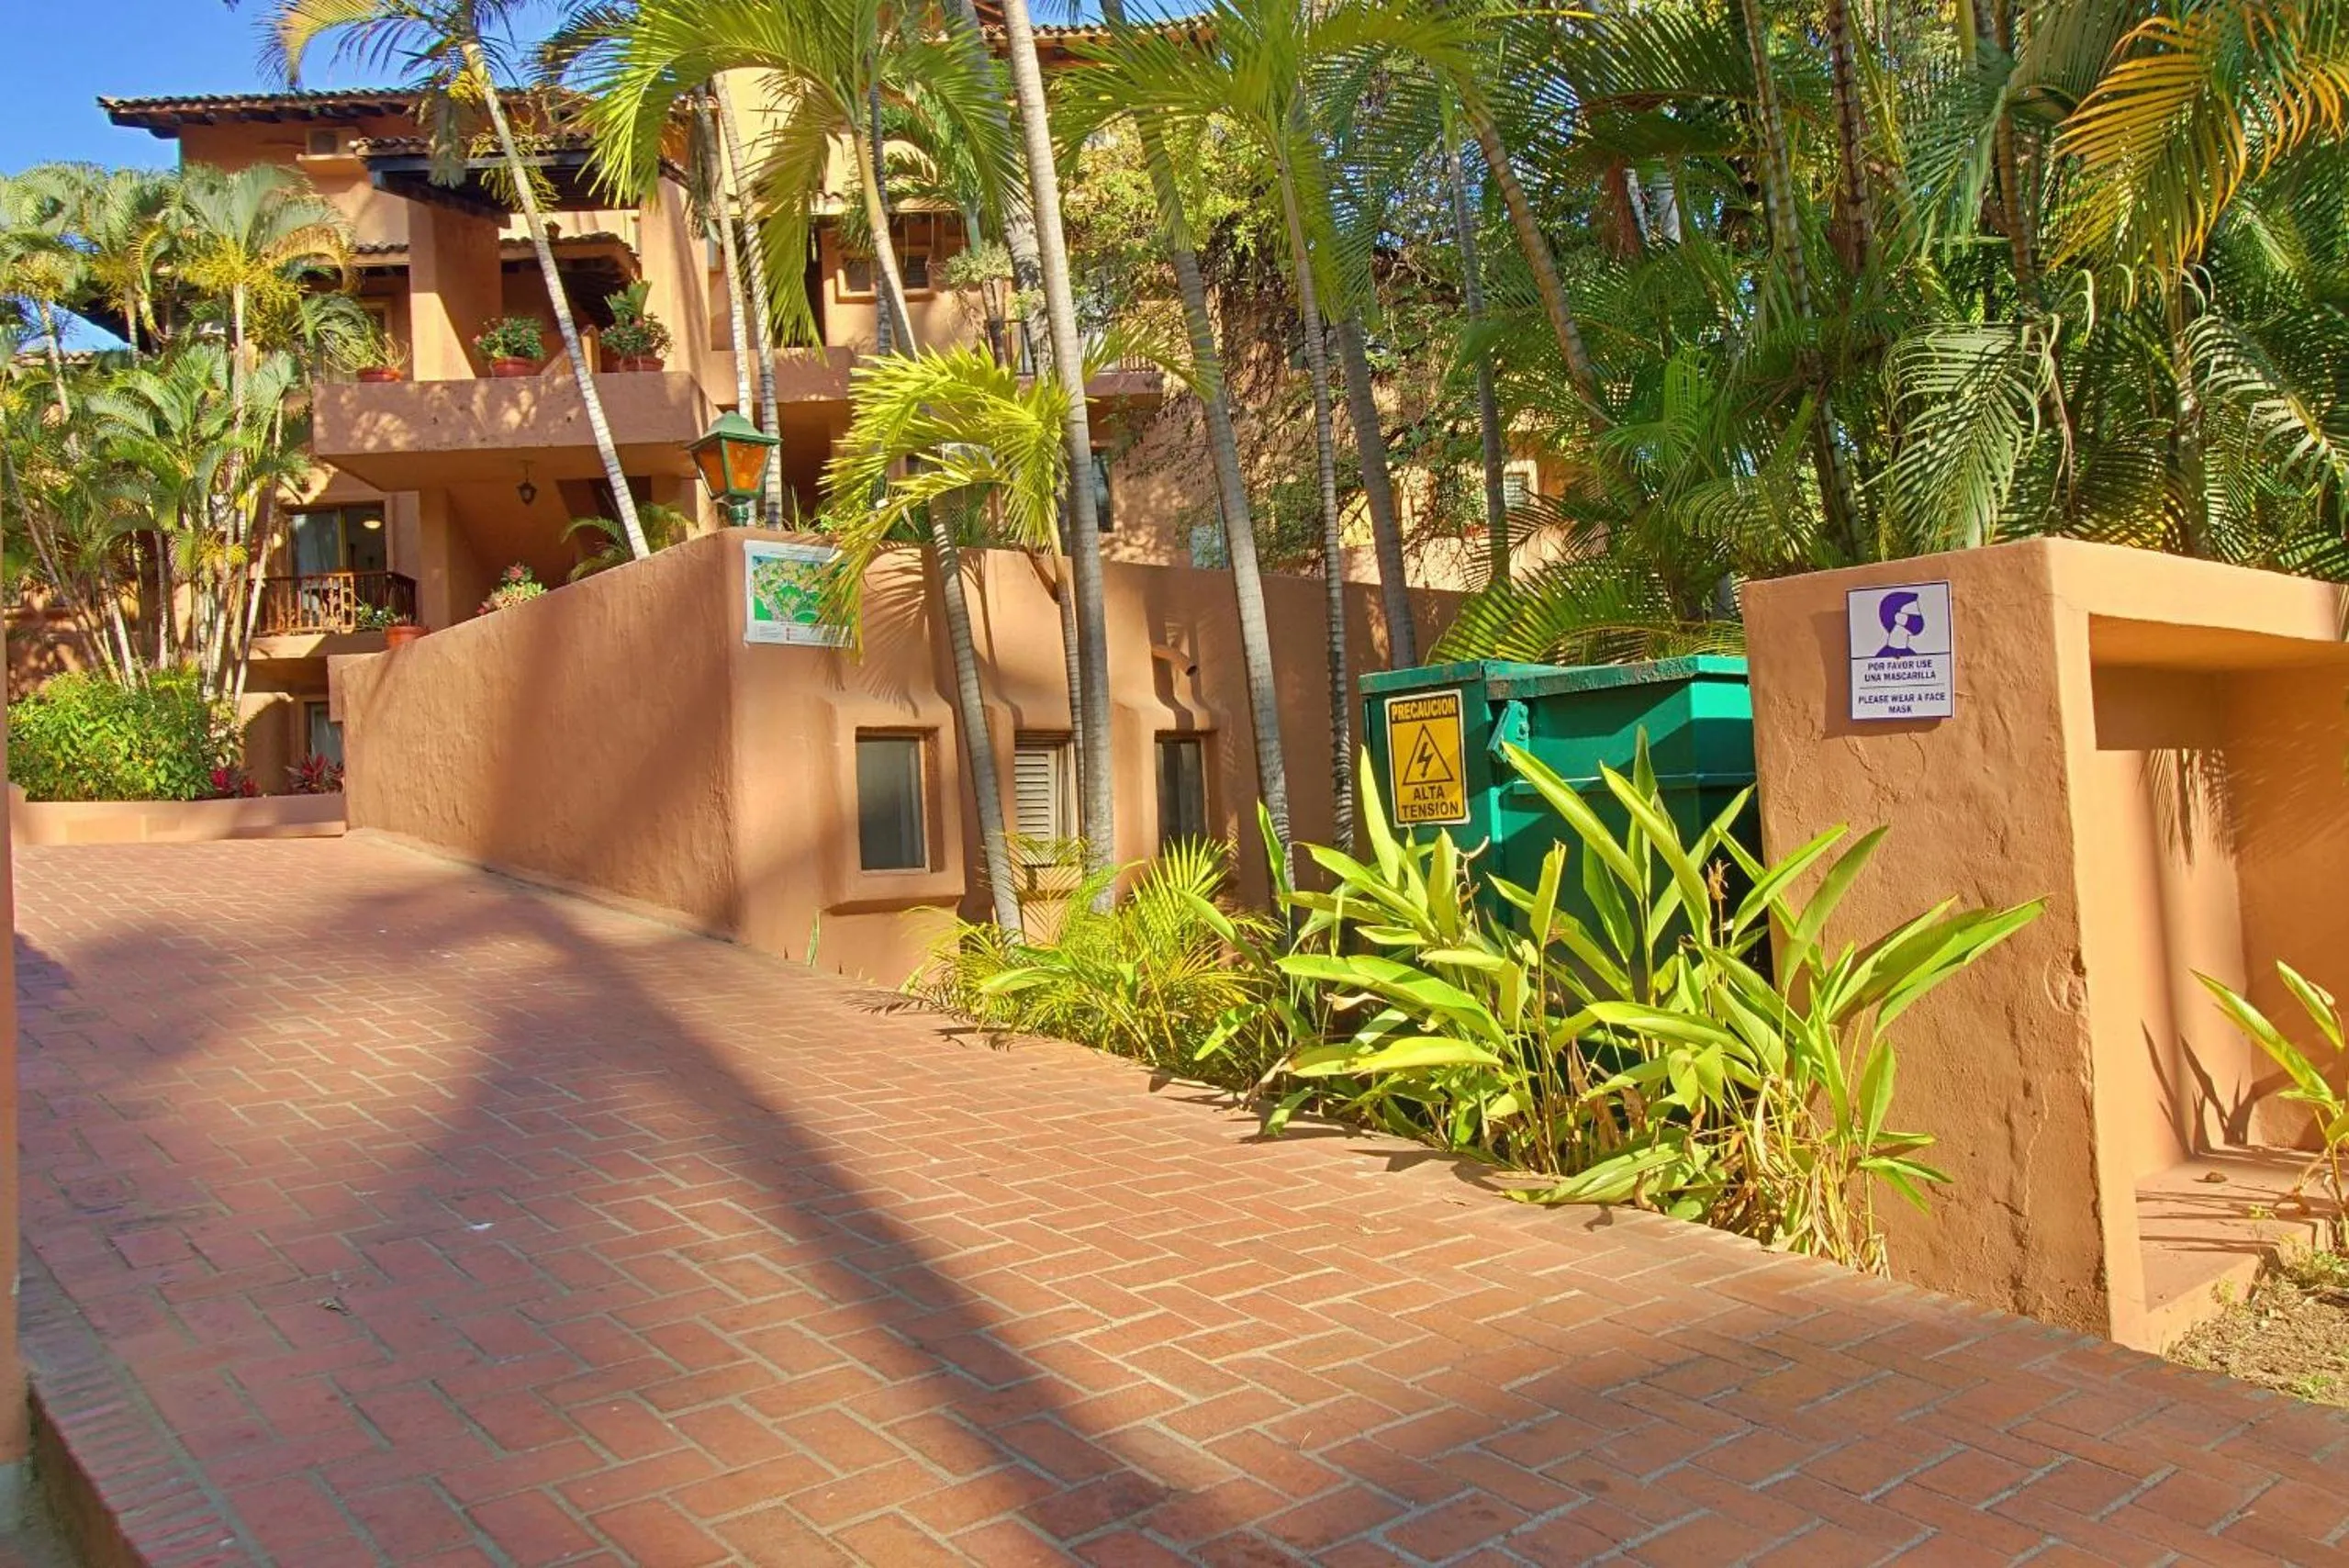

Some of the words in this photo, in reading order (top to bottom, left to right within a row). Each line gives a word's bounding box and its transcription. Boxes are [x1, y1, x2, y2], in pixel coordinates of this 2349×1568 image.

[1867, 662, 1885, 671] POR
[1887, 660, 1914, 670] FAVOR
[1916, 659, 1933, 668] USE
[1864, 674, 1882, 682] UNA
[1884, 671, 1937, 681] MASCARILLA
[1858, 694, 1888, 704] PLEASE
[1891, 693, 1915, 703] WEAR
[1918, 693, 1923, 701] A
[1925, 692, 1946, 701] FACE
[1391, 697, 1457, 722] PRECAUCION
[1888, 704, 1913, 714] MASK
[1413, 786, 1446, 801] ALTA
[1401, 801, 1459, 819] TENSION
